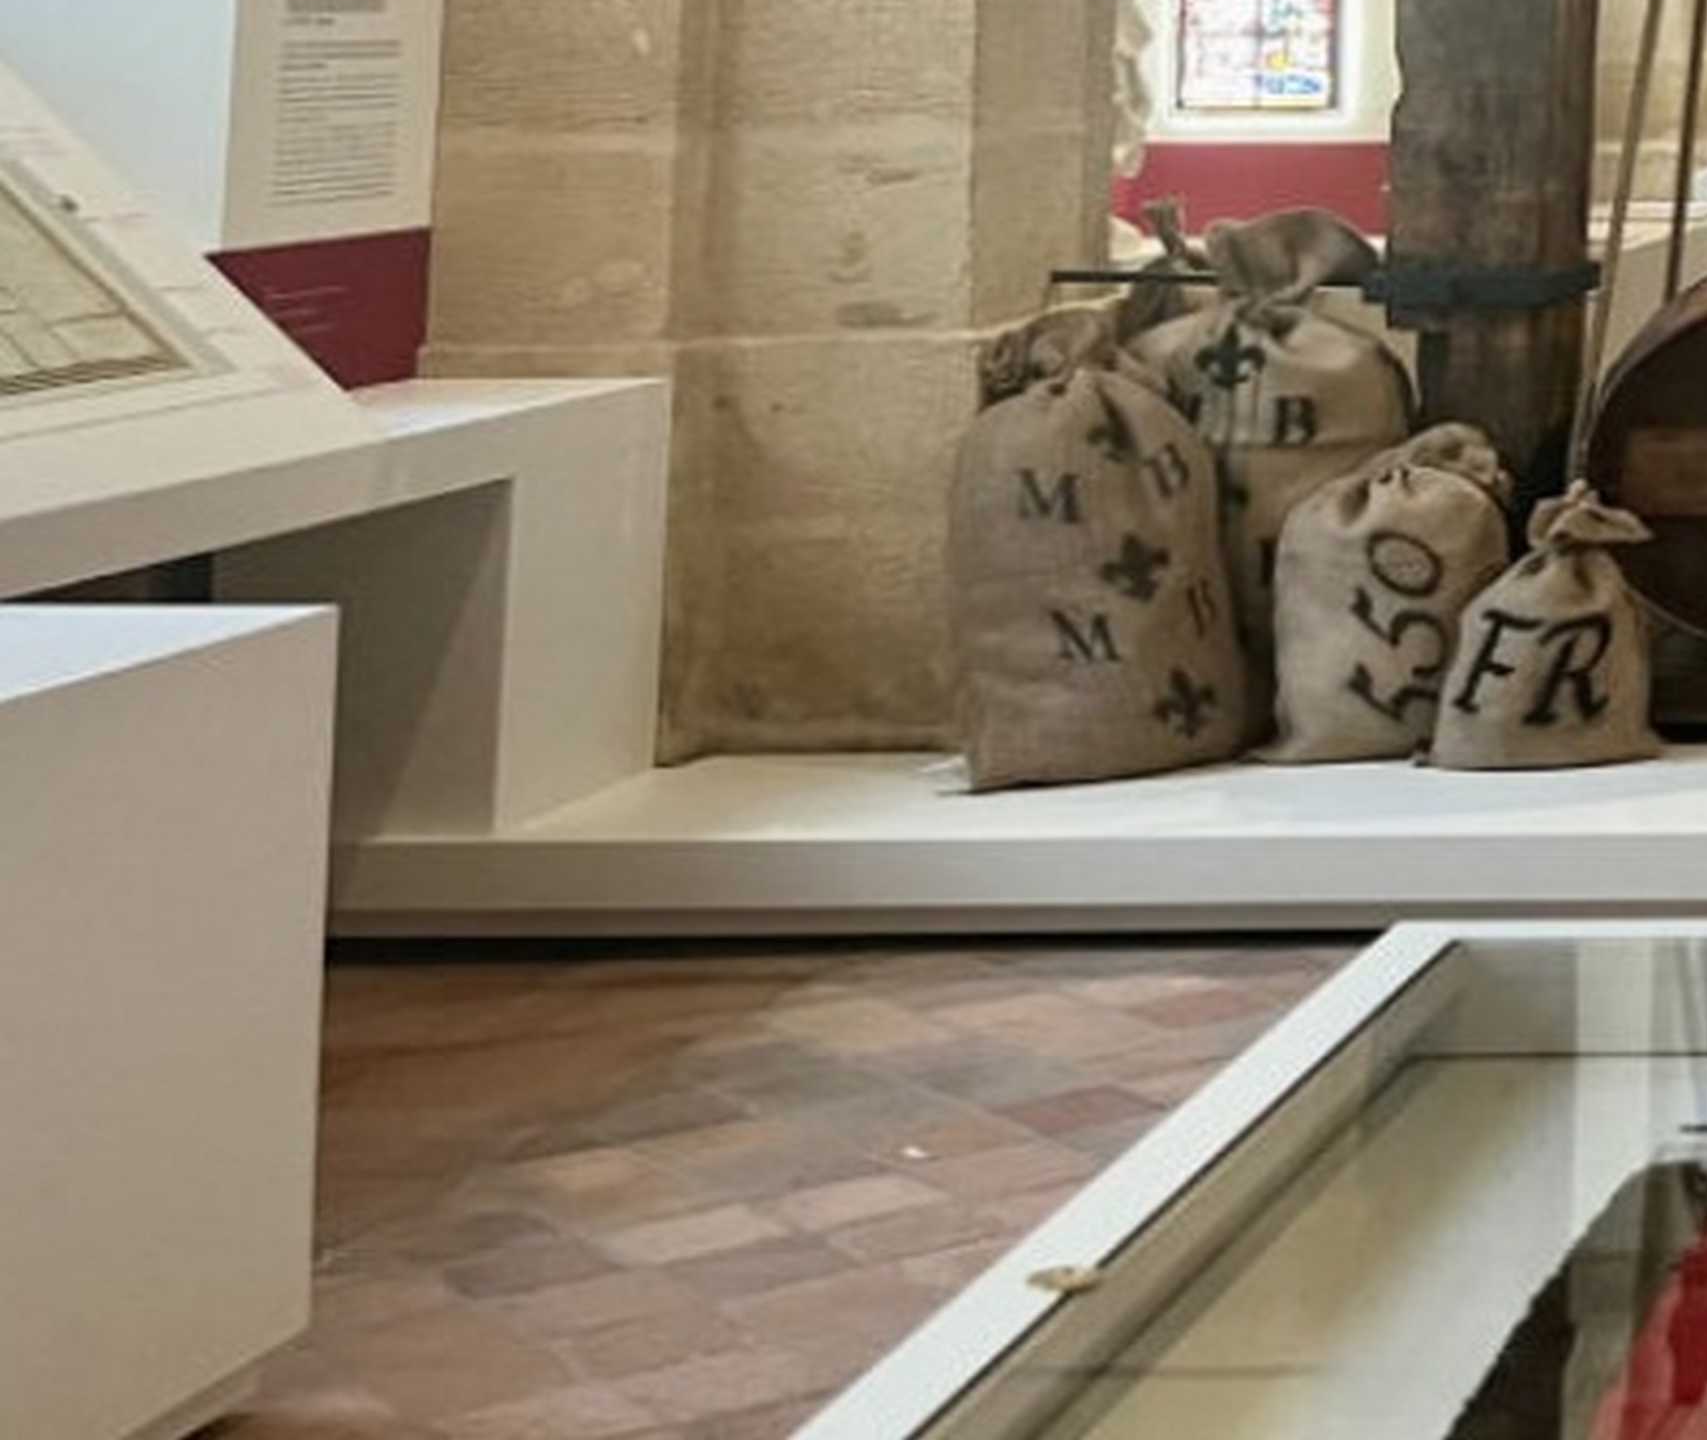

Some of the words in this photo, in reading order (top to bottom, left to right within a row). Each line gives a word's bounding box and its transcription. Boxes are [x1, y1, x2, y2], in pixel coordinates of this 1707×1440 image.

[1271, 394, 1318, 447] B
[1015, 467, 1084, 525] M
[1048, 608, 1122, 662] M
[1455, 608, 1613, 726] FR
